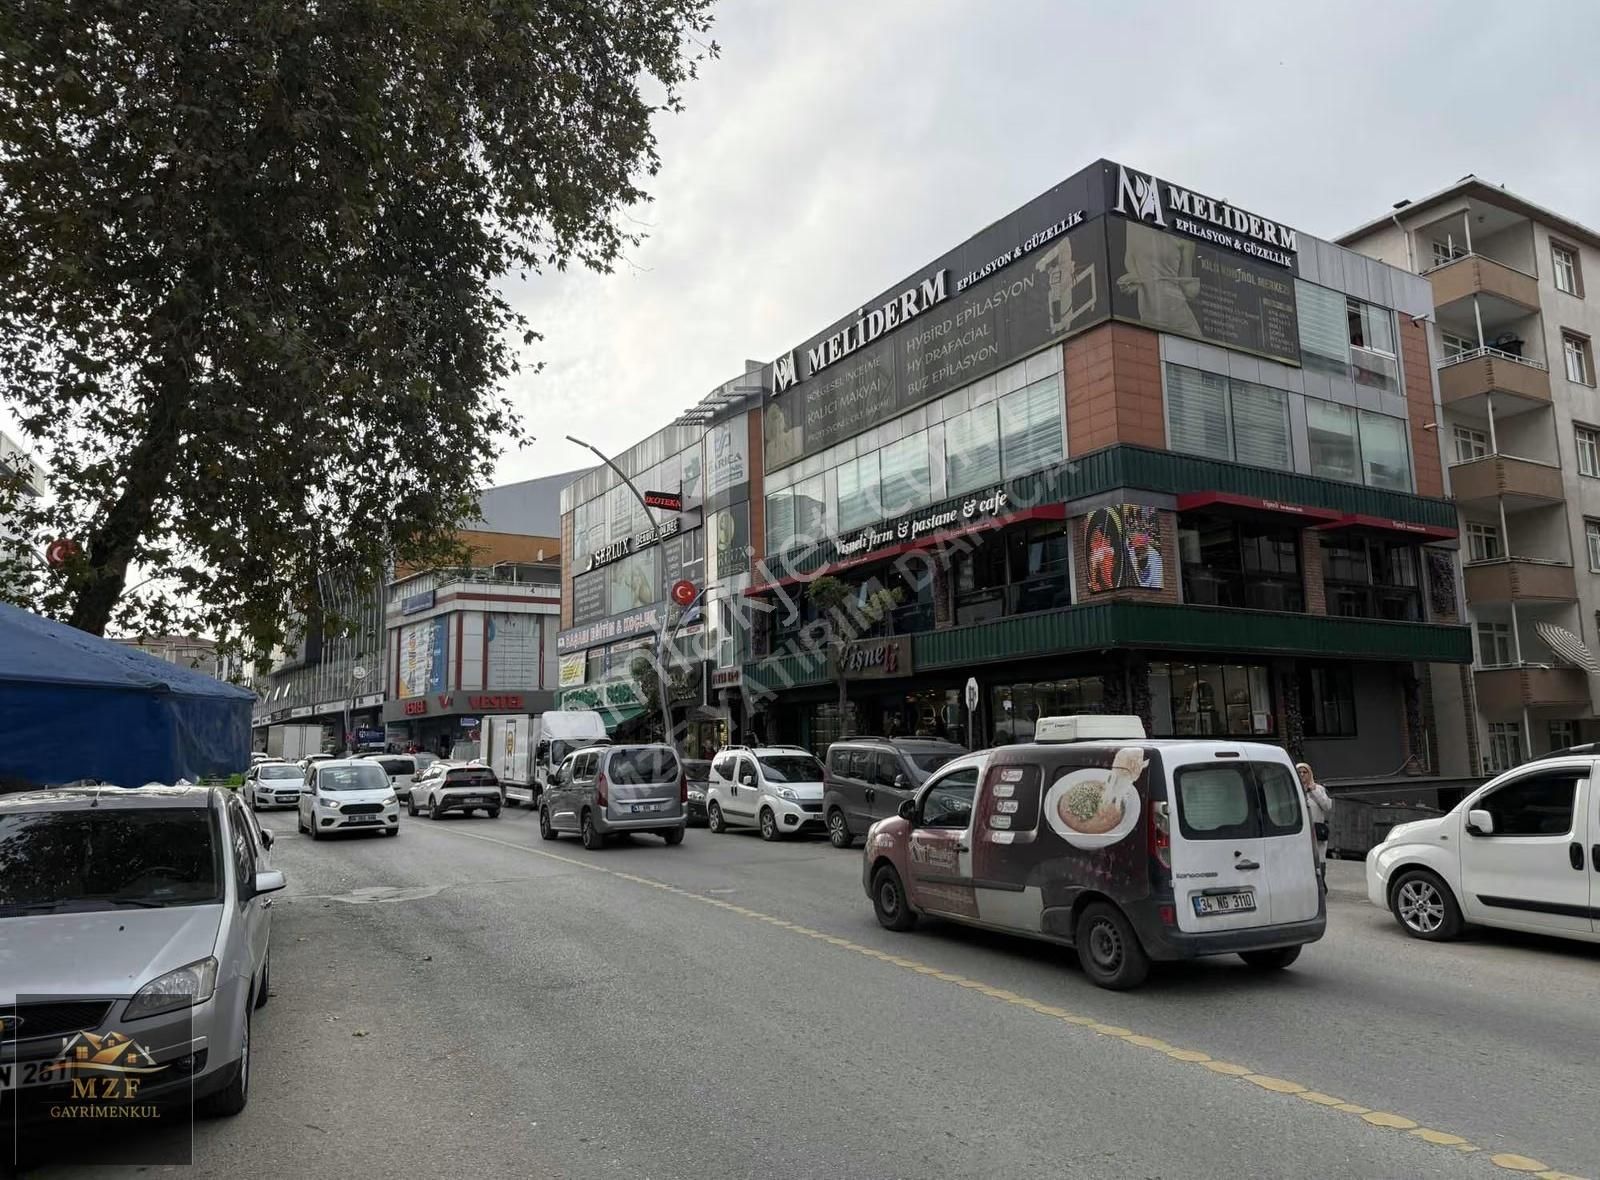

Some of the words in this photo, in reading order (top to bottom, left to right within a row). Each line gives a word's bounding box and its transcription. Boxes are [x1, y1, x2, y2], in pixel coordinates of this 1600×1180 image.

[1167, 185, 1299, 253] MELİDERM
[1175, 218, 1232, 249] EPİLASYON
[1233, 238, 1242, 251] &
[1243, 241, 1292, 268] GÜZELLİK
[956, 252, 1013, 292] EPİLASYON
[1013, 245, 1023, 259] &
[1024, 210, 1084, 252] GÜZELLİK
[807, 268, 949, 377] MELİDERM
[955, 273, 1035, 328] EPİLASYON
[907, 376, 929, 396] BUZ
[932, 342, 999, 384] EPİLASYON
[897, 519, 910, 539] &
[912, 509, 958, 540] pastane
[962, 499, 977, 518] &
[979, 489, 1008, 516] cafe
[1201, 898, 1213, 911] 34
[1233, 894, 1252, 908] 3110
